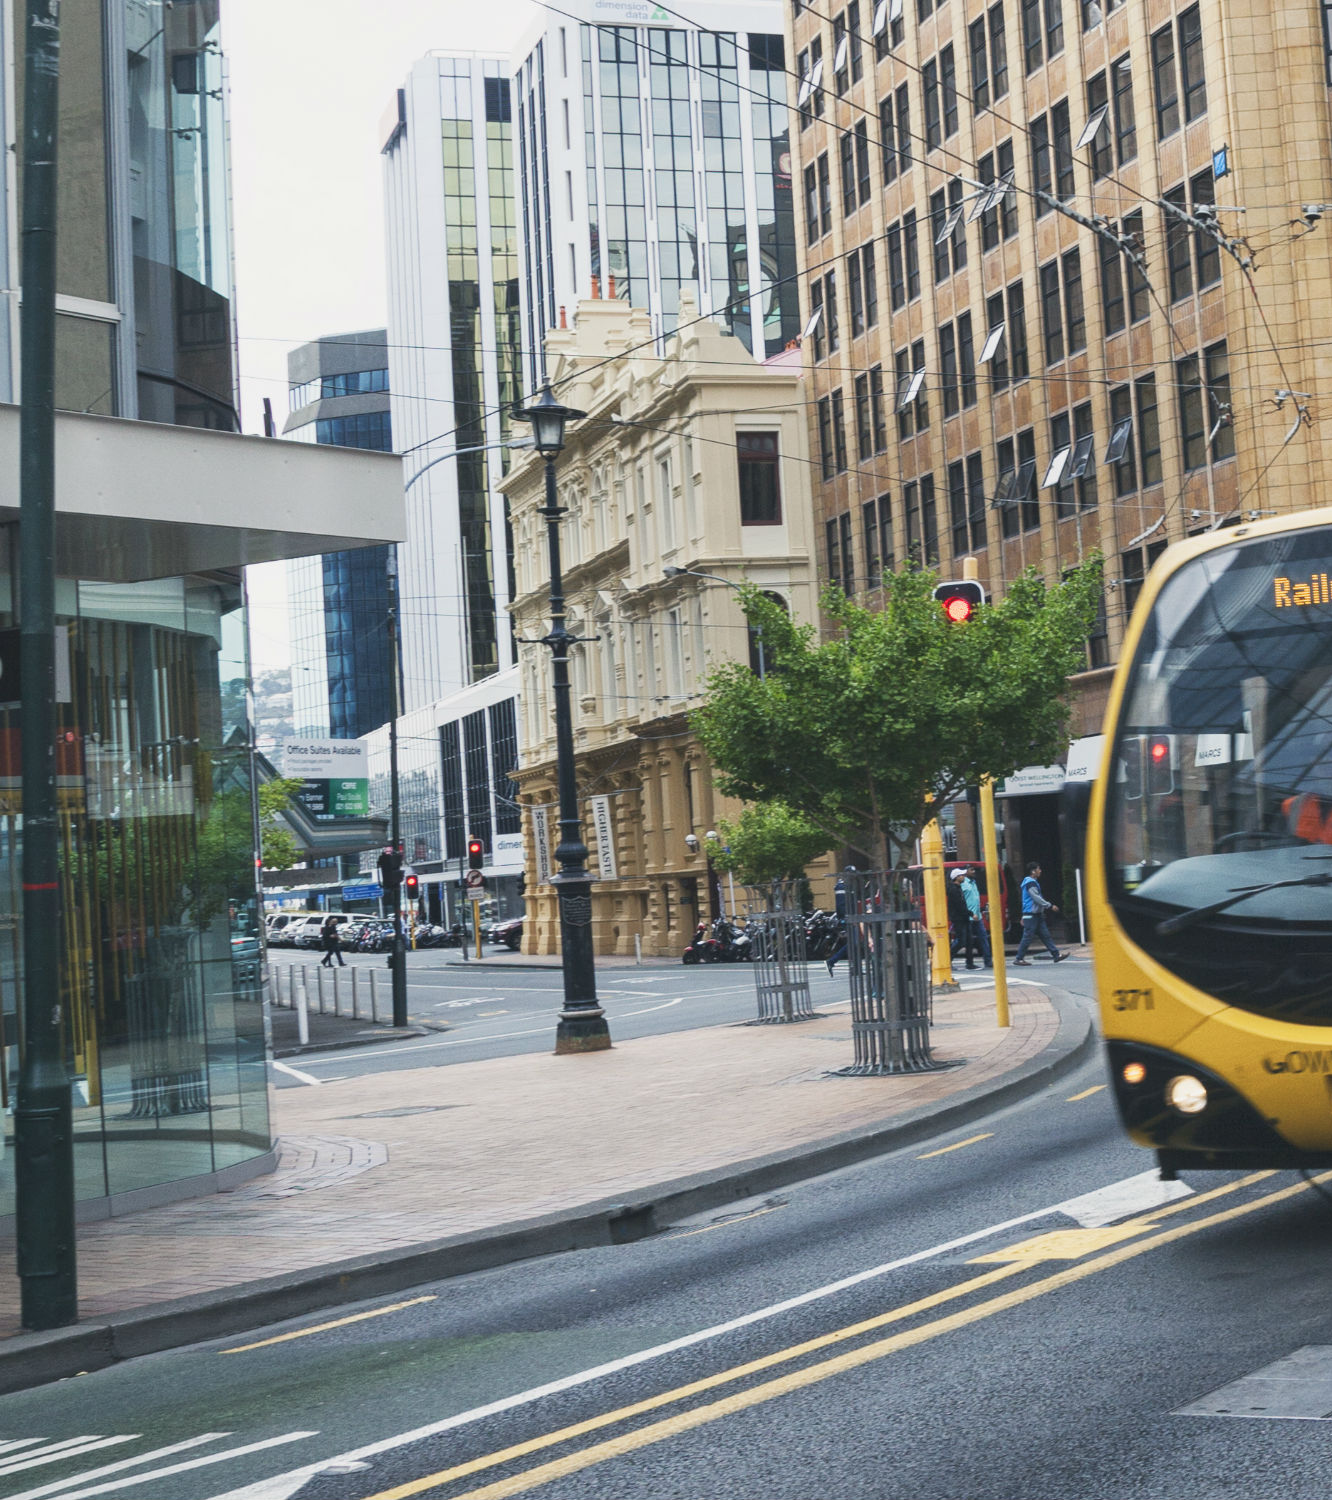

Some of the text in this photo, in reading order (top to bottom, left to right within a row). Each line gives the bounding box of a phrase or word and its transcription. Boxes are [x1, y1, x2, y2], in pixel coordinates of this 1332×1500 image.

[595, 1, 648, 11] dimension
[625, 11, 648, 20] data
[287, 745, 361, 756] Office Suites Available
[1198, 748, 1223, 760] MARCS
[596, 801, 614, 876] HIGHER TASTE
[533, 810, 548, 881] WORKSHOP
[1113, 988, 1155, 1012] 371
